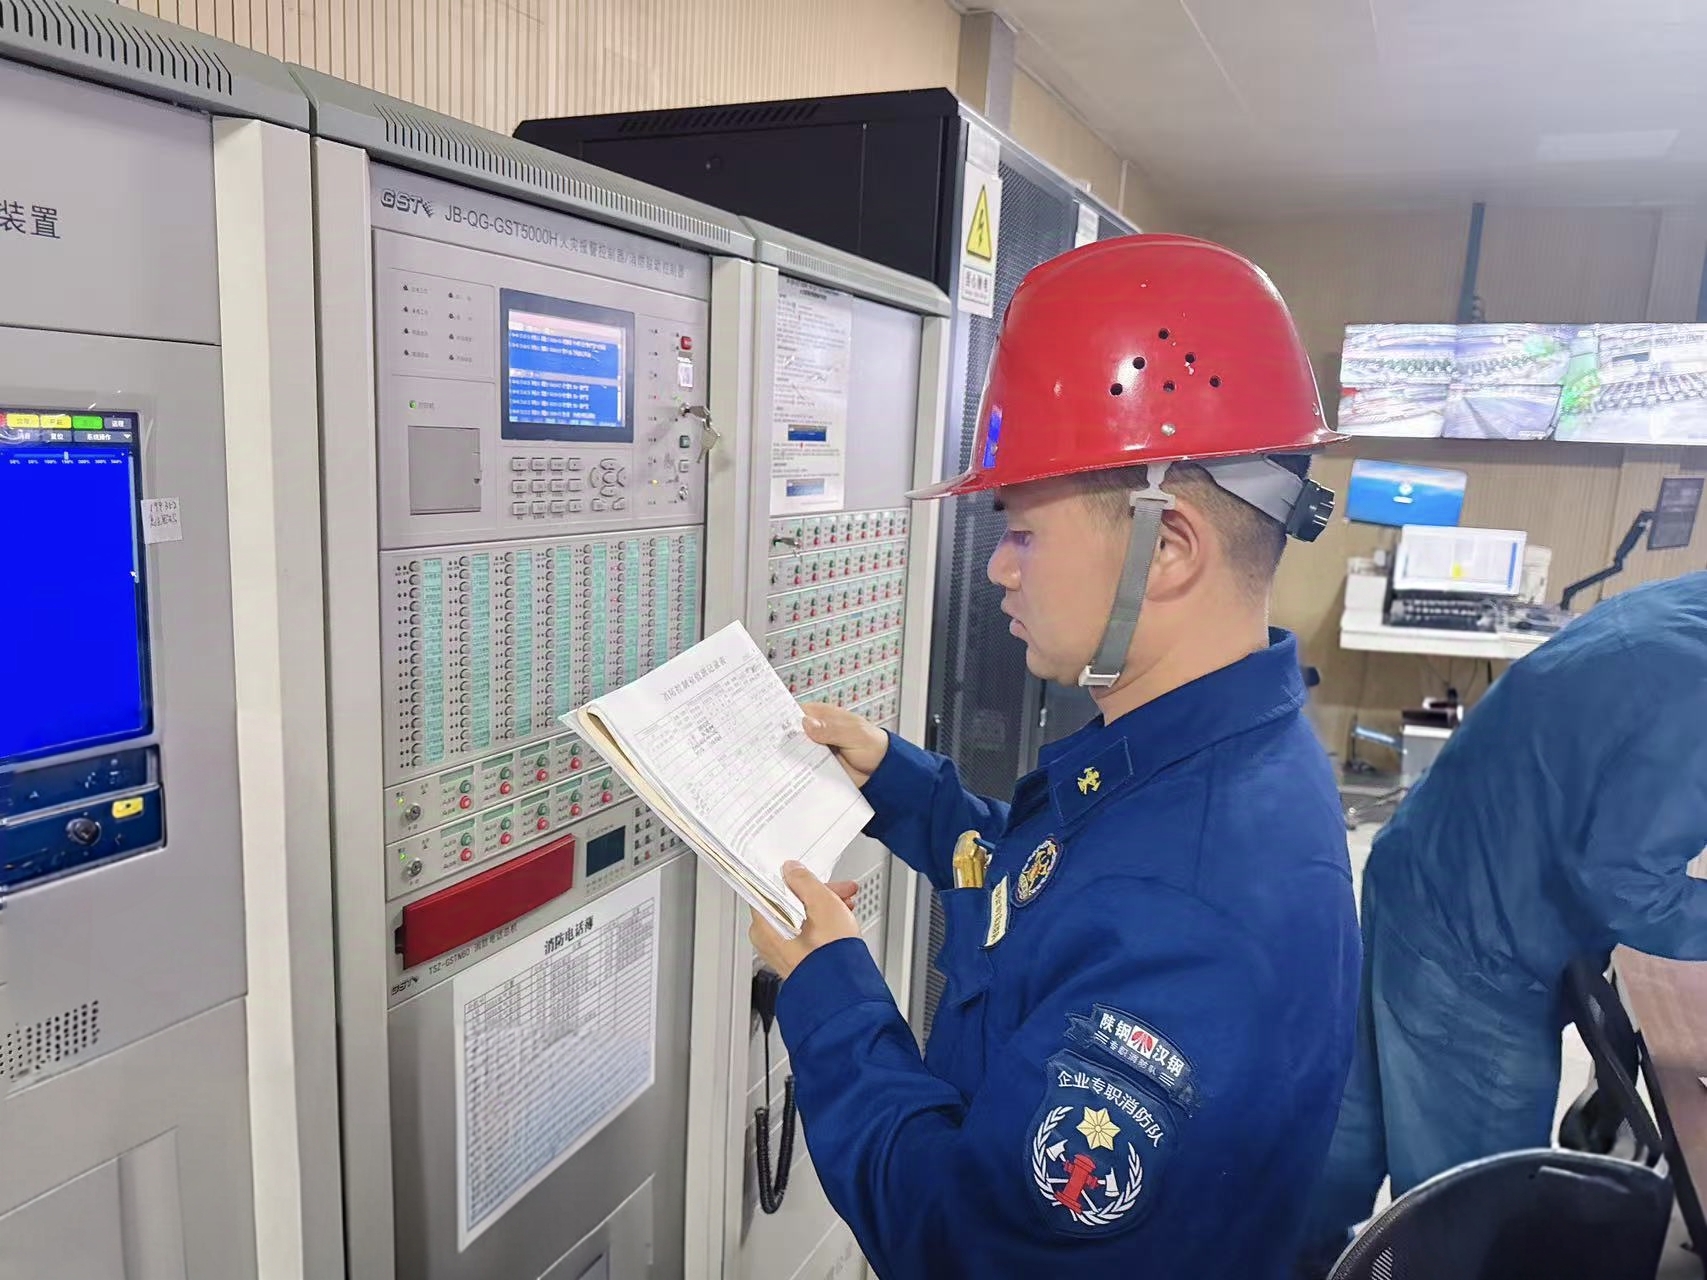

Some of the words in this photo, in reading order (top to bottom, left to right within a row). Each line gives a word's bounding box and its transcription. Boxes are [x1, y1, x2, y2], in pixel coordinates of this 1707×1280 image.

[0, 200, 61, 239] 装置
[381, 189, 424, 217] GST
[1099, 1012, 1132, 1042] 陕钢
[1152, 1044, 1185, 1077] 汉钢
[1109, 1040, 1158, 1076] 专职消防队
[1057, 1070, 1165, 1148] 企业专职消防队
